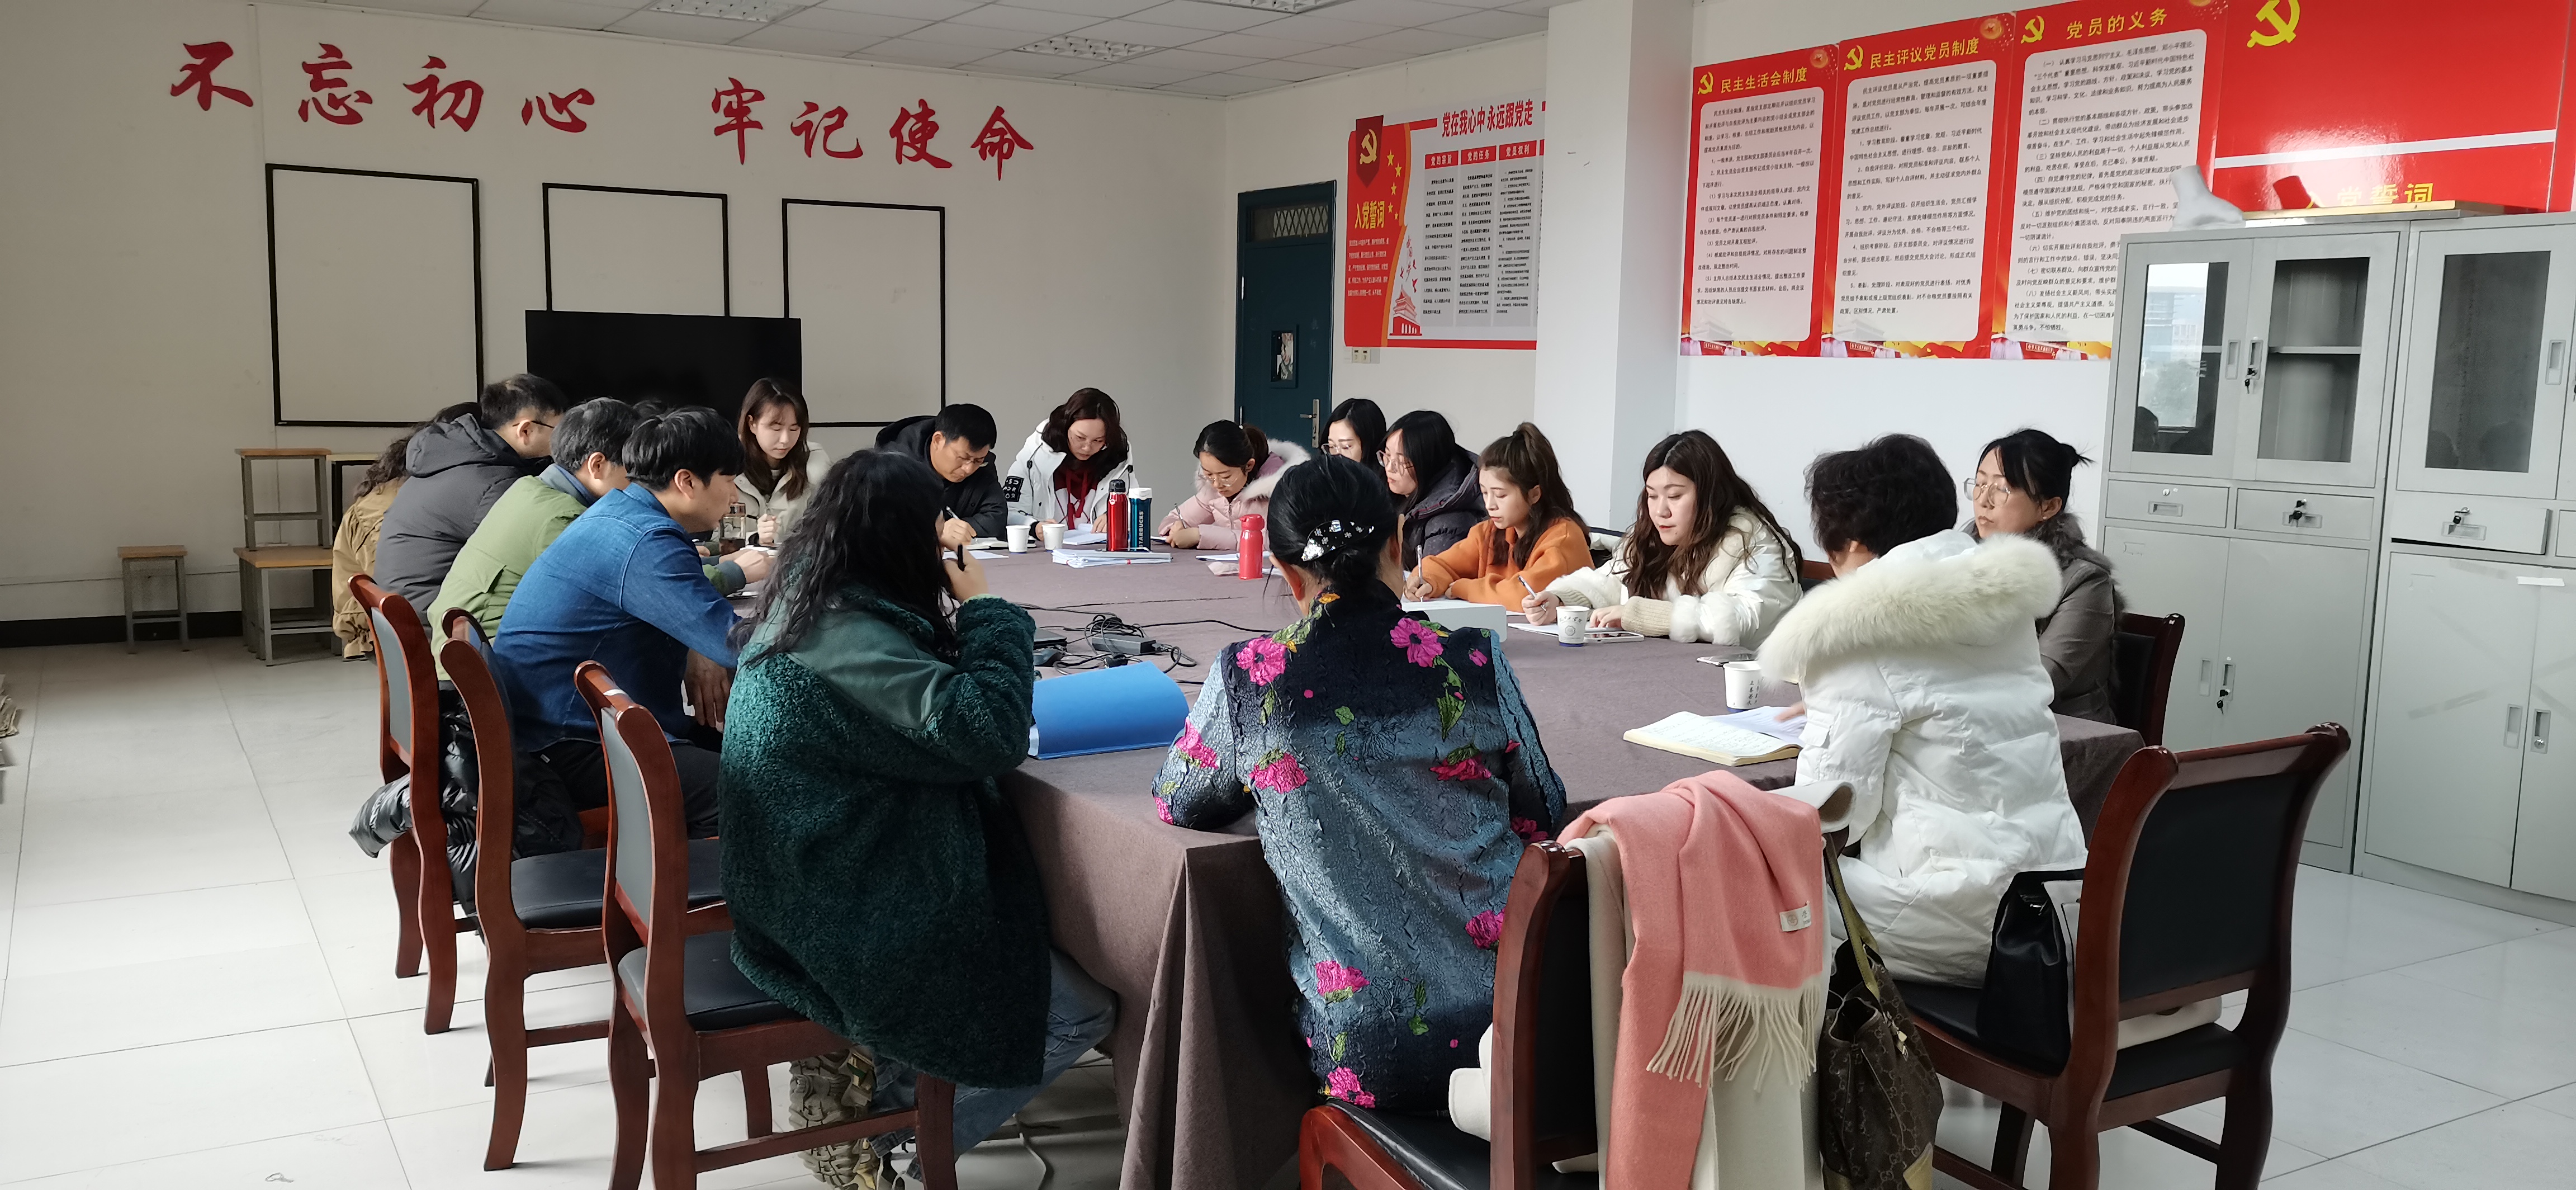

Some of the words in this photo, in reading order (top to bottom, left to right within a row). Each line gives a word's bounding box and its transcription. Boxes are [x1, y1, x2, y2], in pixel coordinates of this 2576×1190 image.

[2066, 7, 2167, 40] 党员的义务
[1870, 37, 1979, 69] 民主评议党员制度
[1721, 67, 1807, 94] 民主生活会制度
[171, 42, 594, 133] 不忘初心
[712, 78, 1033, 180] 牢记使命
[1442, 107, 1485, 138] 党在我心中
[1486, 98, 1533, 131] 永远跟党走
[1431, 154, 1452, 167] 党的宗旨
[1467, 149, 1489, 162] 党的任务
[1506, 144, 1530, 157] 党员权利
[2306, 183, 2434, 209] 入党誓词
[1355, 200, 1385, 229] 入党誓词
